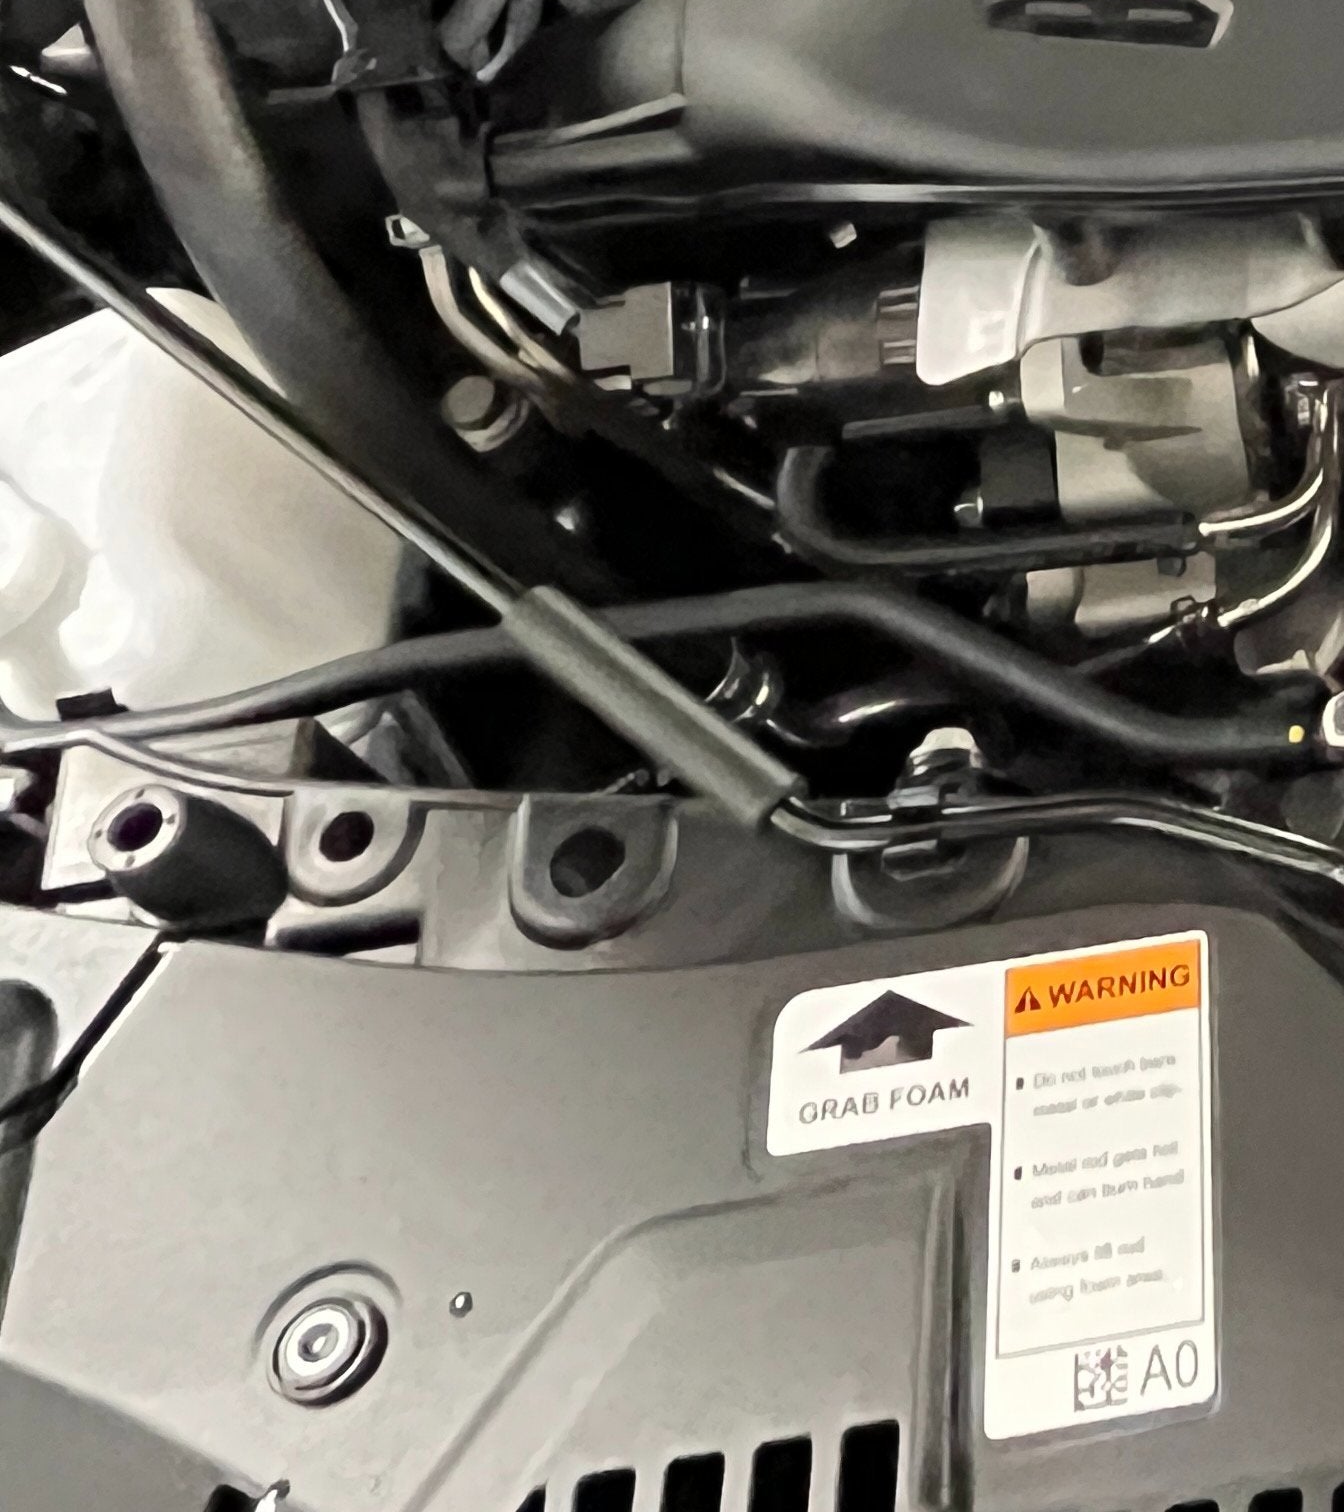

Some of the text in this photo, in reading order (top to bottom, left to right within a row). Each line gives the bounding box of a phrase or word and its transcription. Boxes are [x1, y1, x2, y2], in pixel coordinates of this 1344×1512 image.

[1048, 964, 1190, 1009] WARNING
[798, 1077, 970, 1125] GRAB FOAM
[1139, 1339, 1199, 1397] A0
